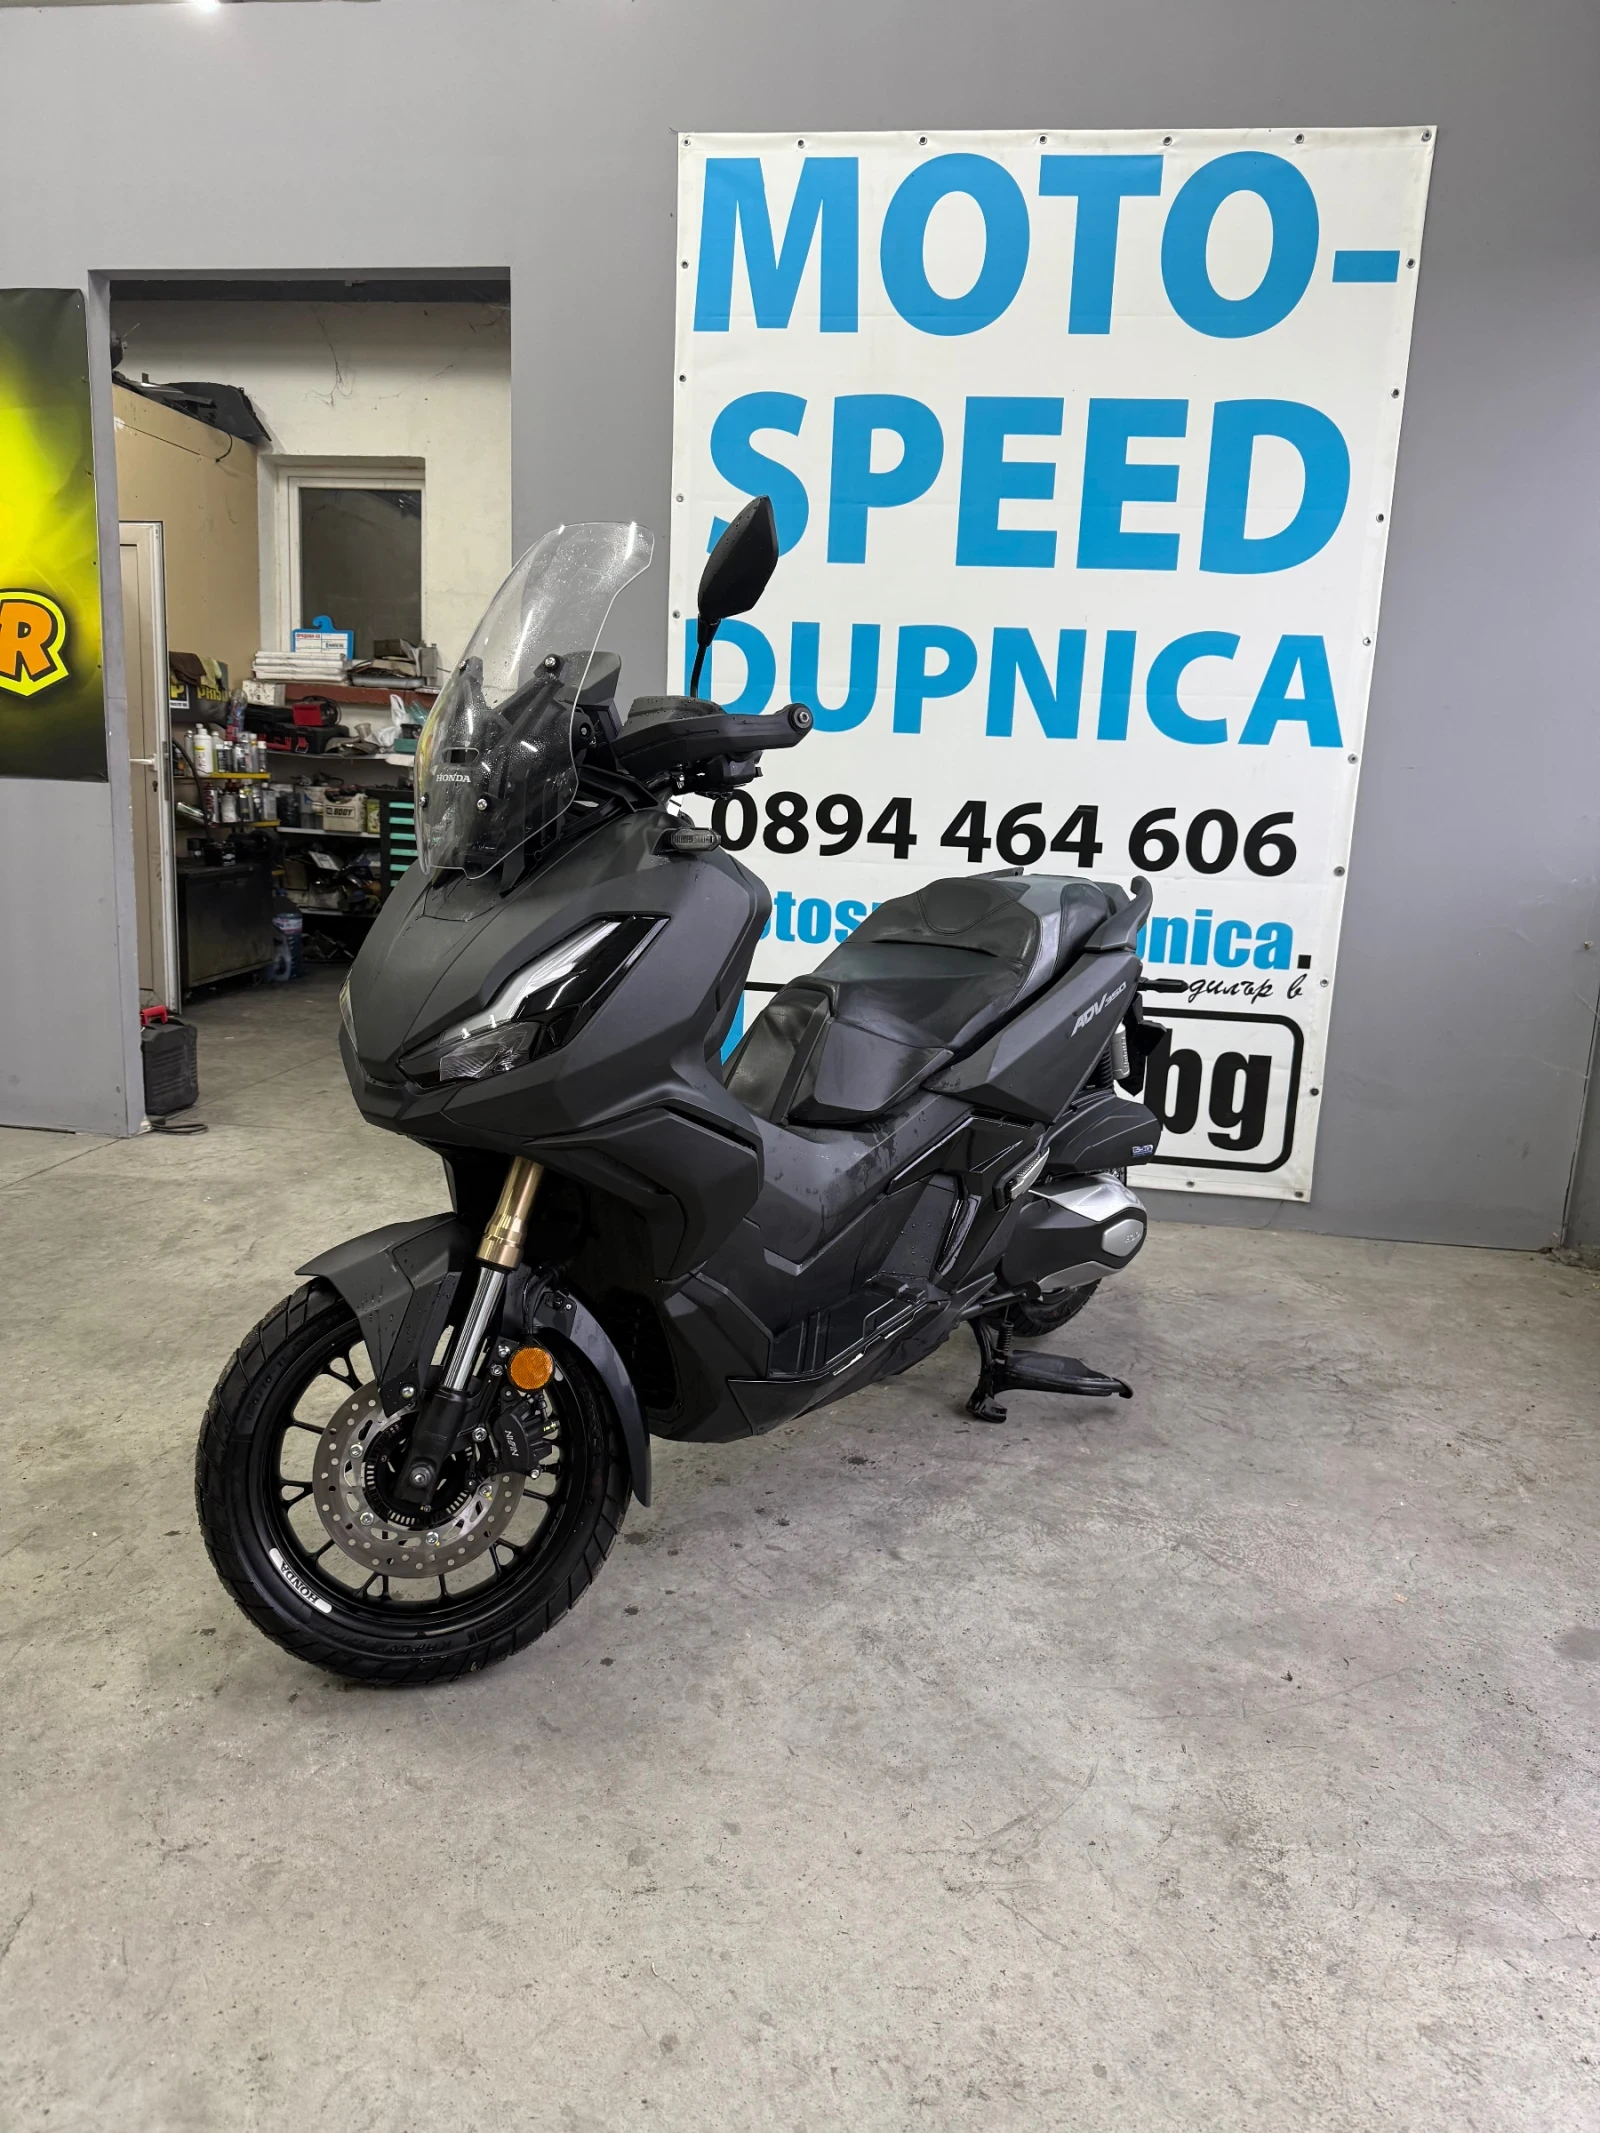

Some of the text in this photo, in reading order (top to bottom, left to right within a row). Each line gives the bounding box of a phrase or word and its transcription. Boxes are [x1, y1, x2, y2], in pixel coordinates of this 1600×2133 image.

[692, 151, 1400, 338] MOTO-
[706, 391, 1351, 574] SPEED
[685, 618, 1343, 747] DUPNICA
[333, 808, 353, 816] BODY
[436, 774, 471, 783] HONDA
[711, 788, 1296, 877] 0894 464 606
[281, 1560, 319, 1604] HONDA
